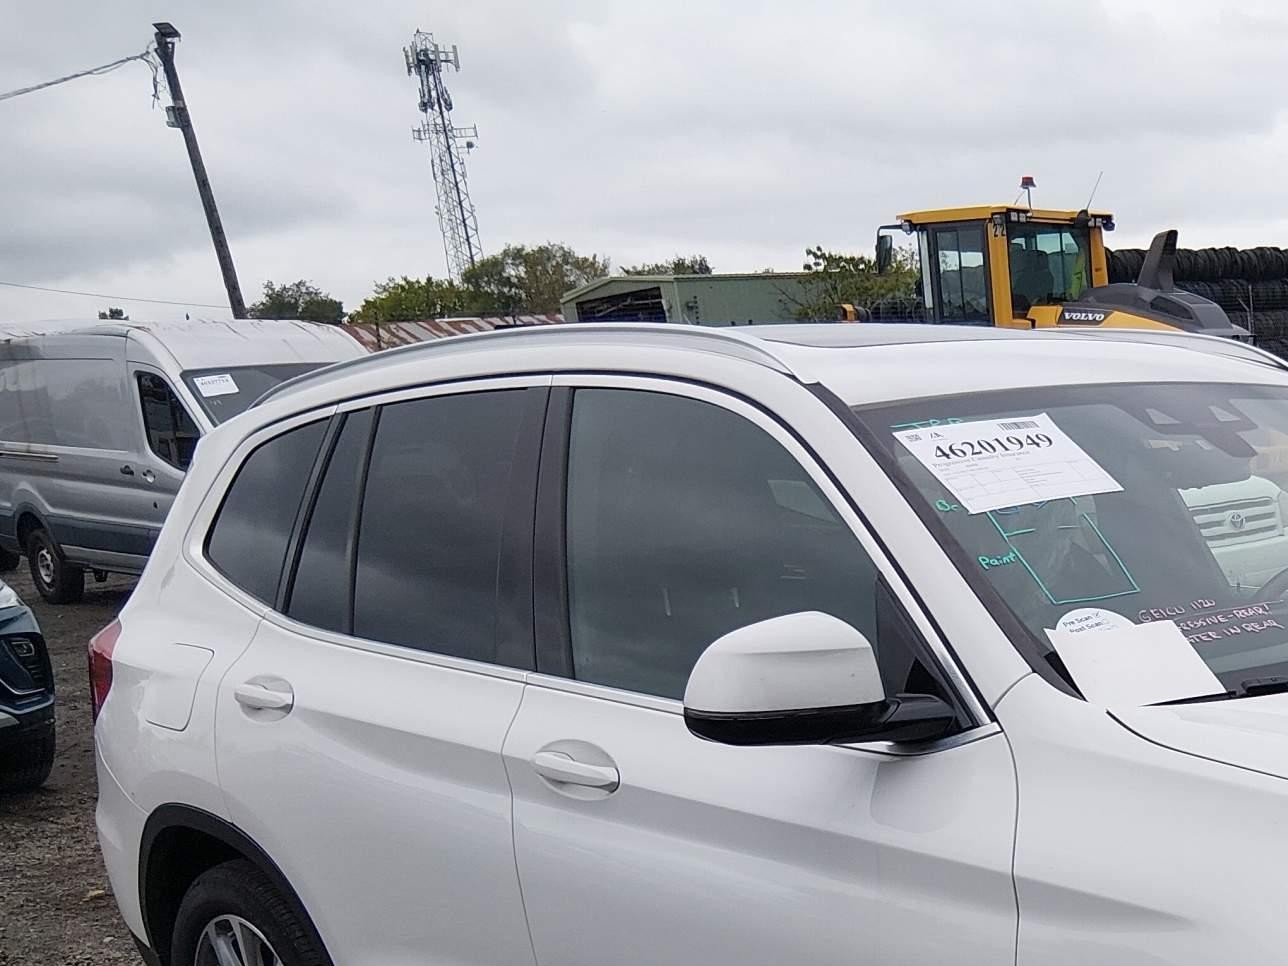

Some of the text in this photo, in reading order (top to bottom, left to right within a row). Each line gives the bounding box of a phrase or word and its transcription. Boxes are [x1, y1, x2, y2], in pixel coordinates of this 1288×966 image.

[1064, 312, 1105, 321] VOLVO
[934, 433, 1053, 459] 46201949
[978, 552, 1016, 570] Paint
